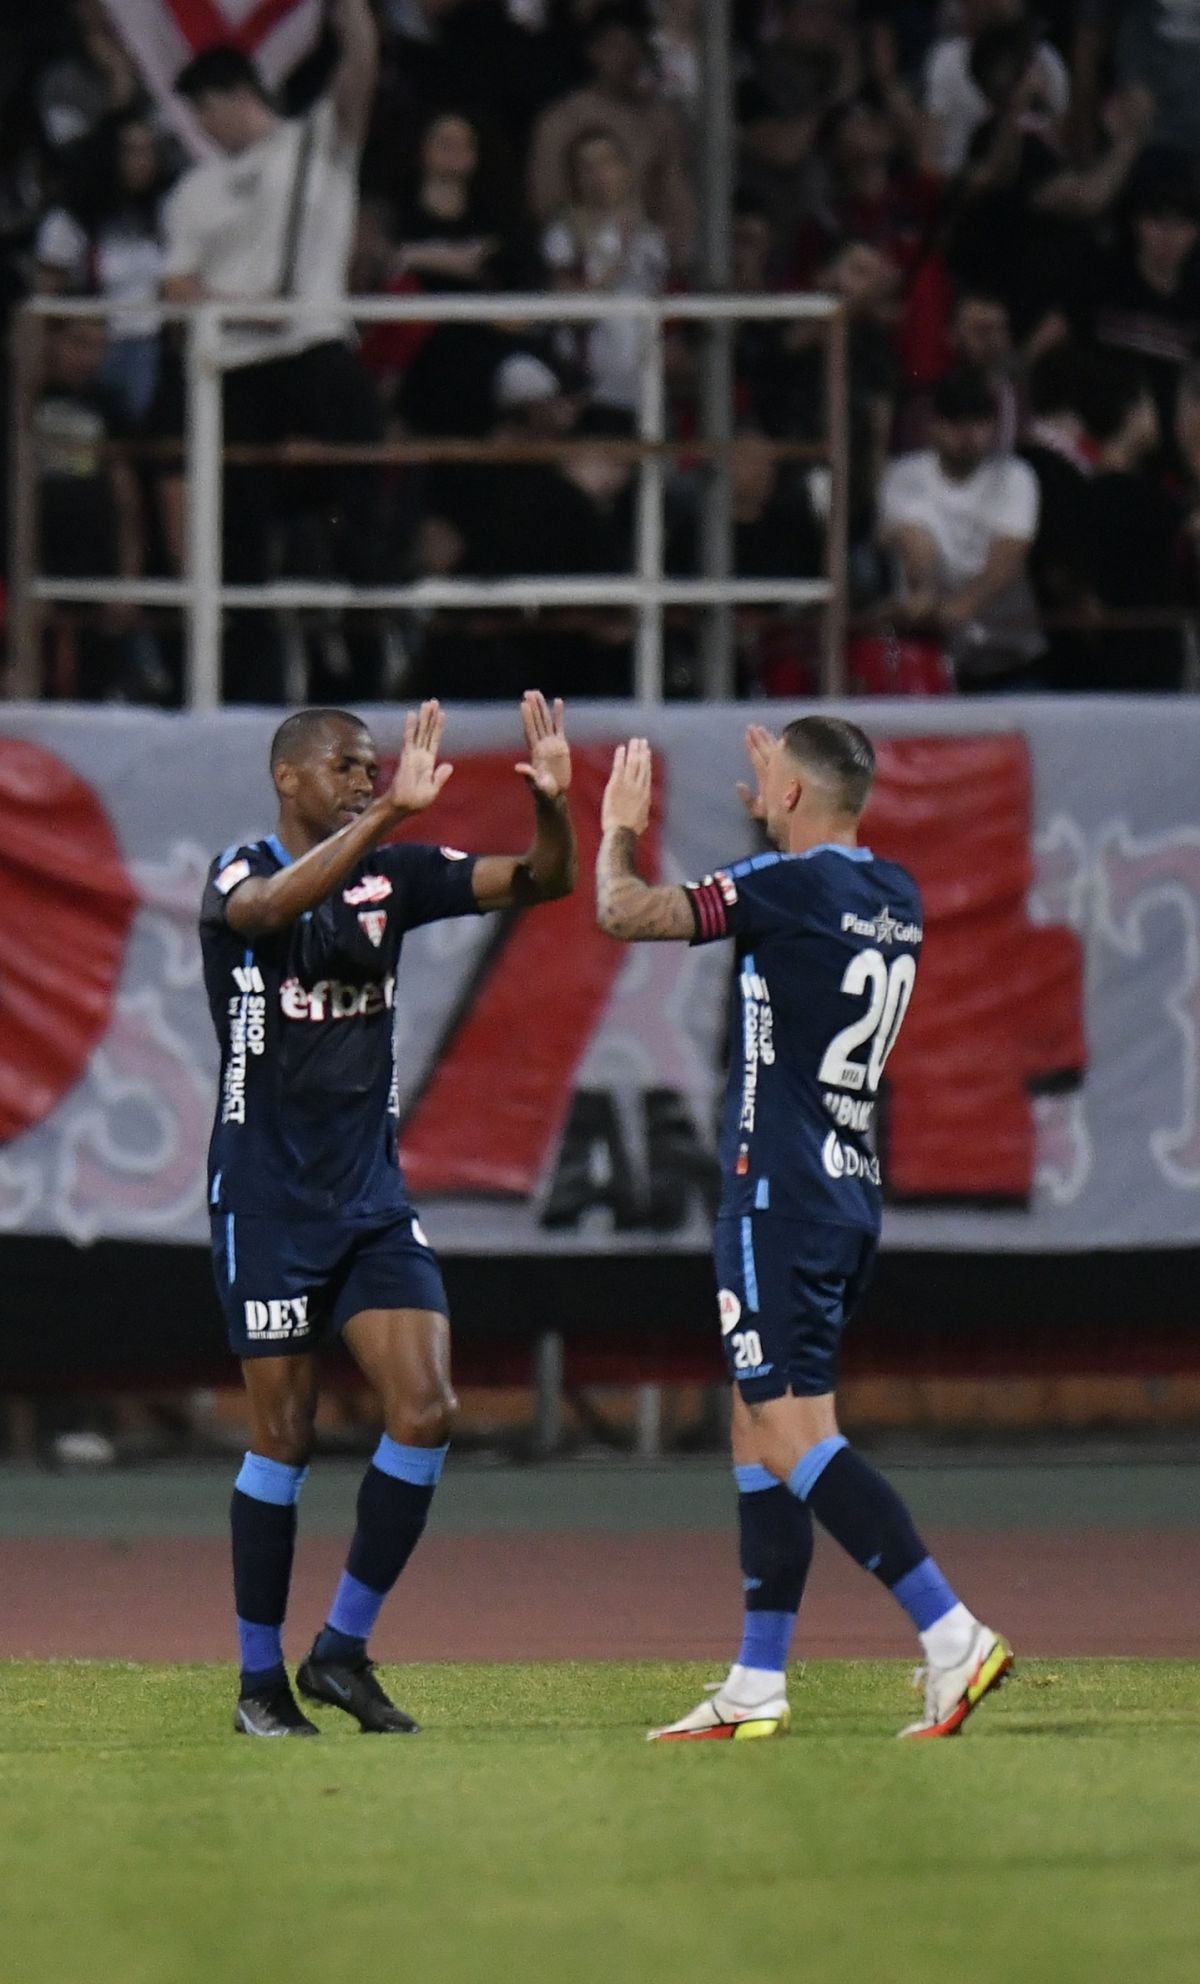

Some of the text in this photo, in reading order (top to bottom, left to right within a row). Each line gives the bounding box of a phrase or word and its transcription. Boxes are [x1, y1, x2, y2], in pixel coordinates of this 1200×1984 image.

[247, 995, 266, 1055] SHOP
[759, 1004, 776, 1066] SHOP
[817, 947, 916, 1092] 20
[740, 1000, 759, 1132] CONSTRUCT
[244, 1295, 308, 1330] DEY
[731, 1329, 763, 1369] 20
